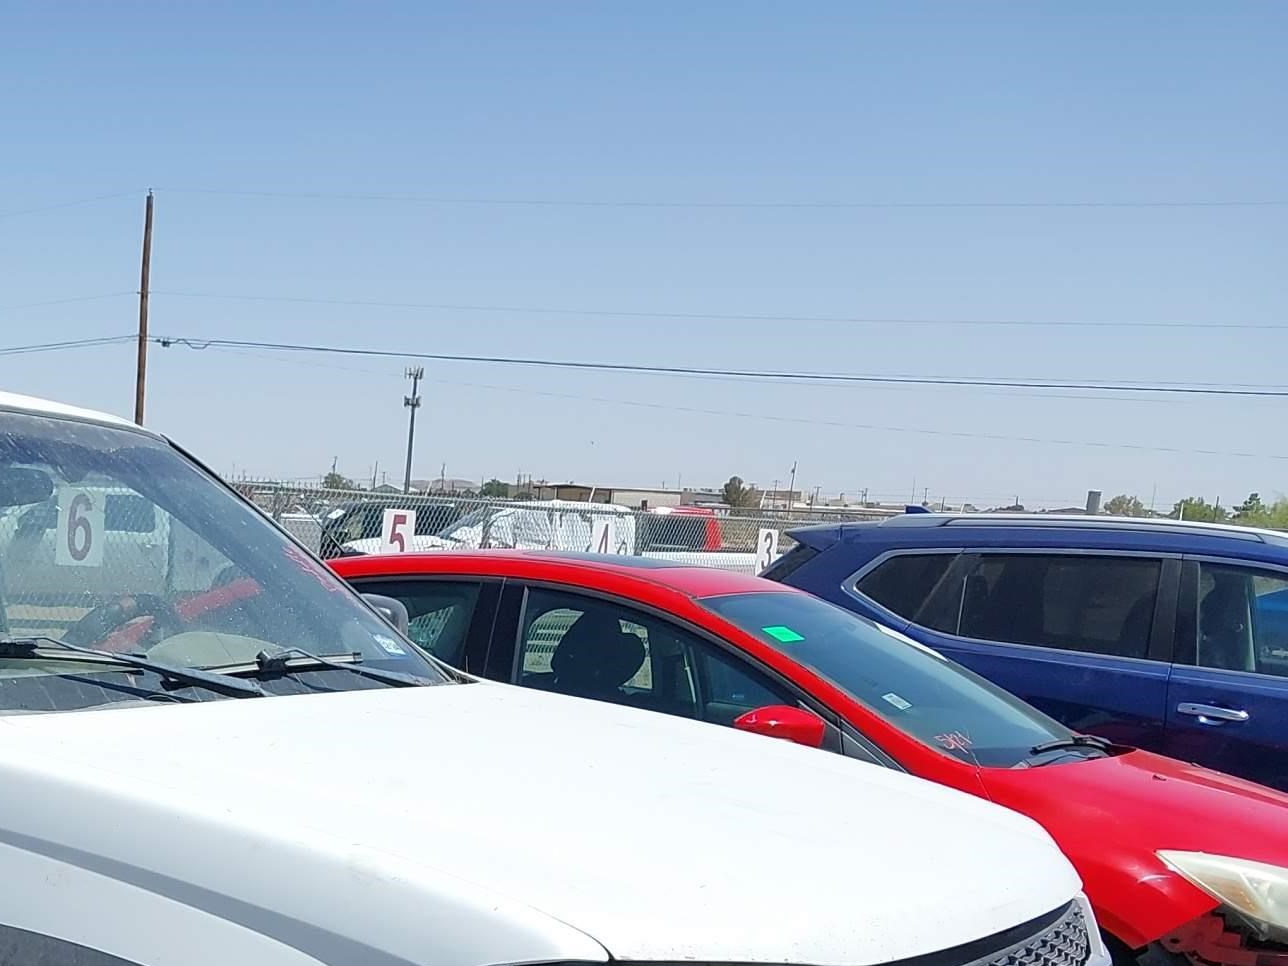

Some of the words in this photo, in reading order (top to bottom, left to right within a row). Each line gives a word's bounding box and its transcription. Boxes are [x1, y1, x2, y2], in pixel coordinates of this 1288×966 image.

[68, 494, 93, 561] 6
[389, 514, 408, 552] 5
[761, 532, 773, 569] 3
